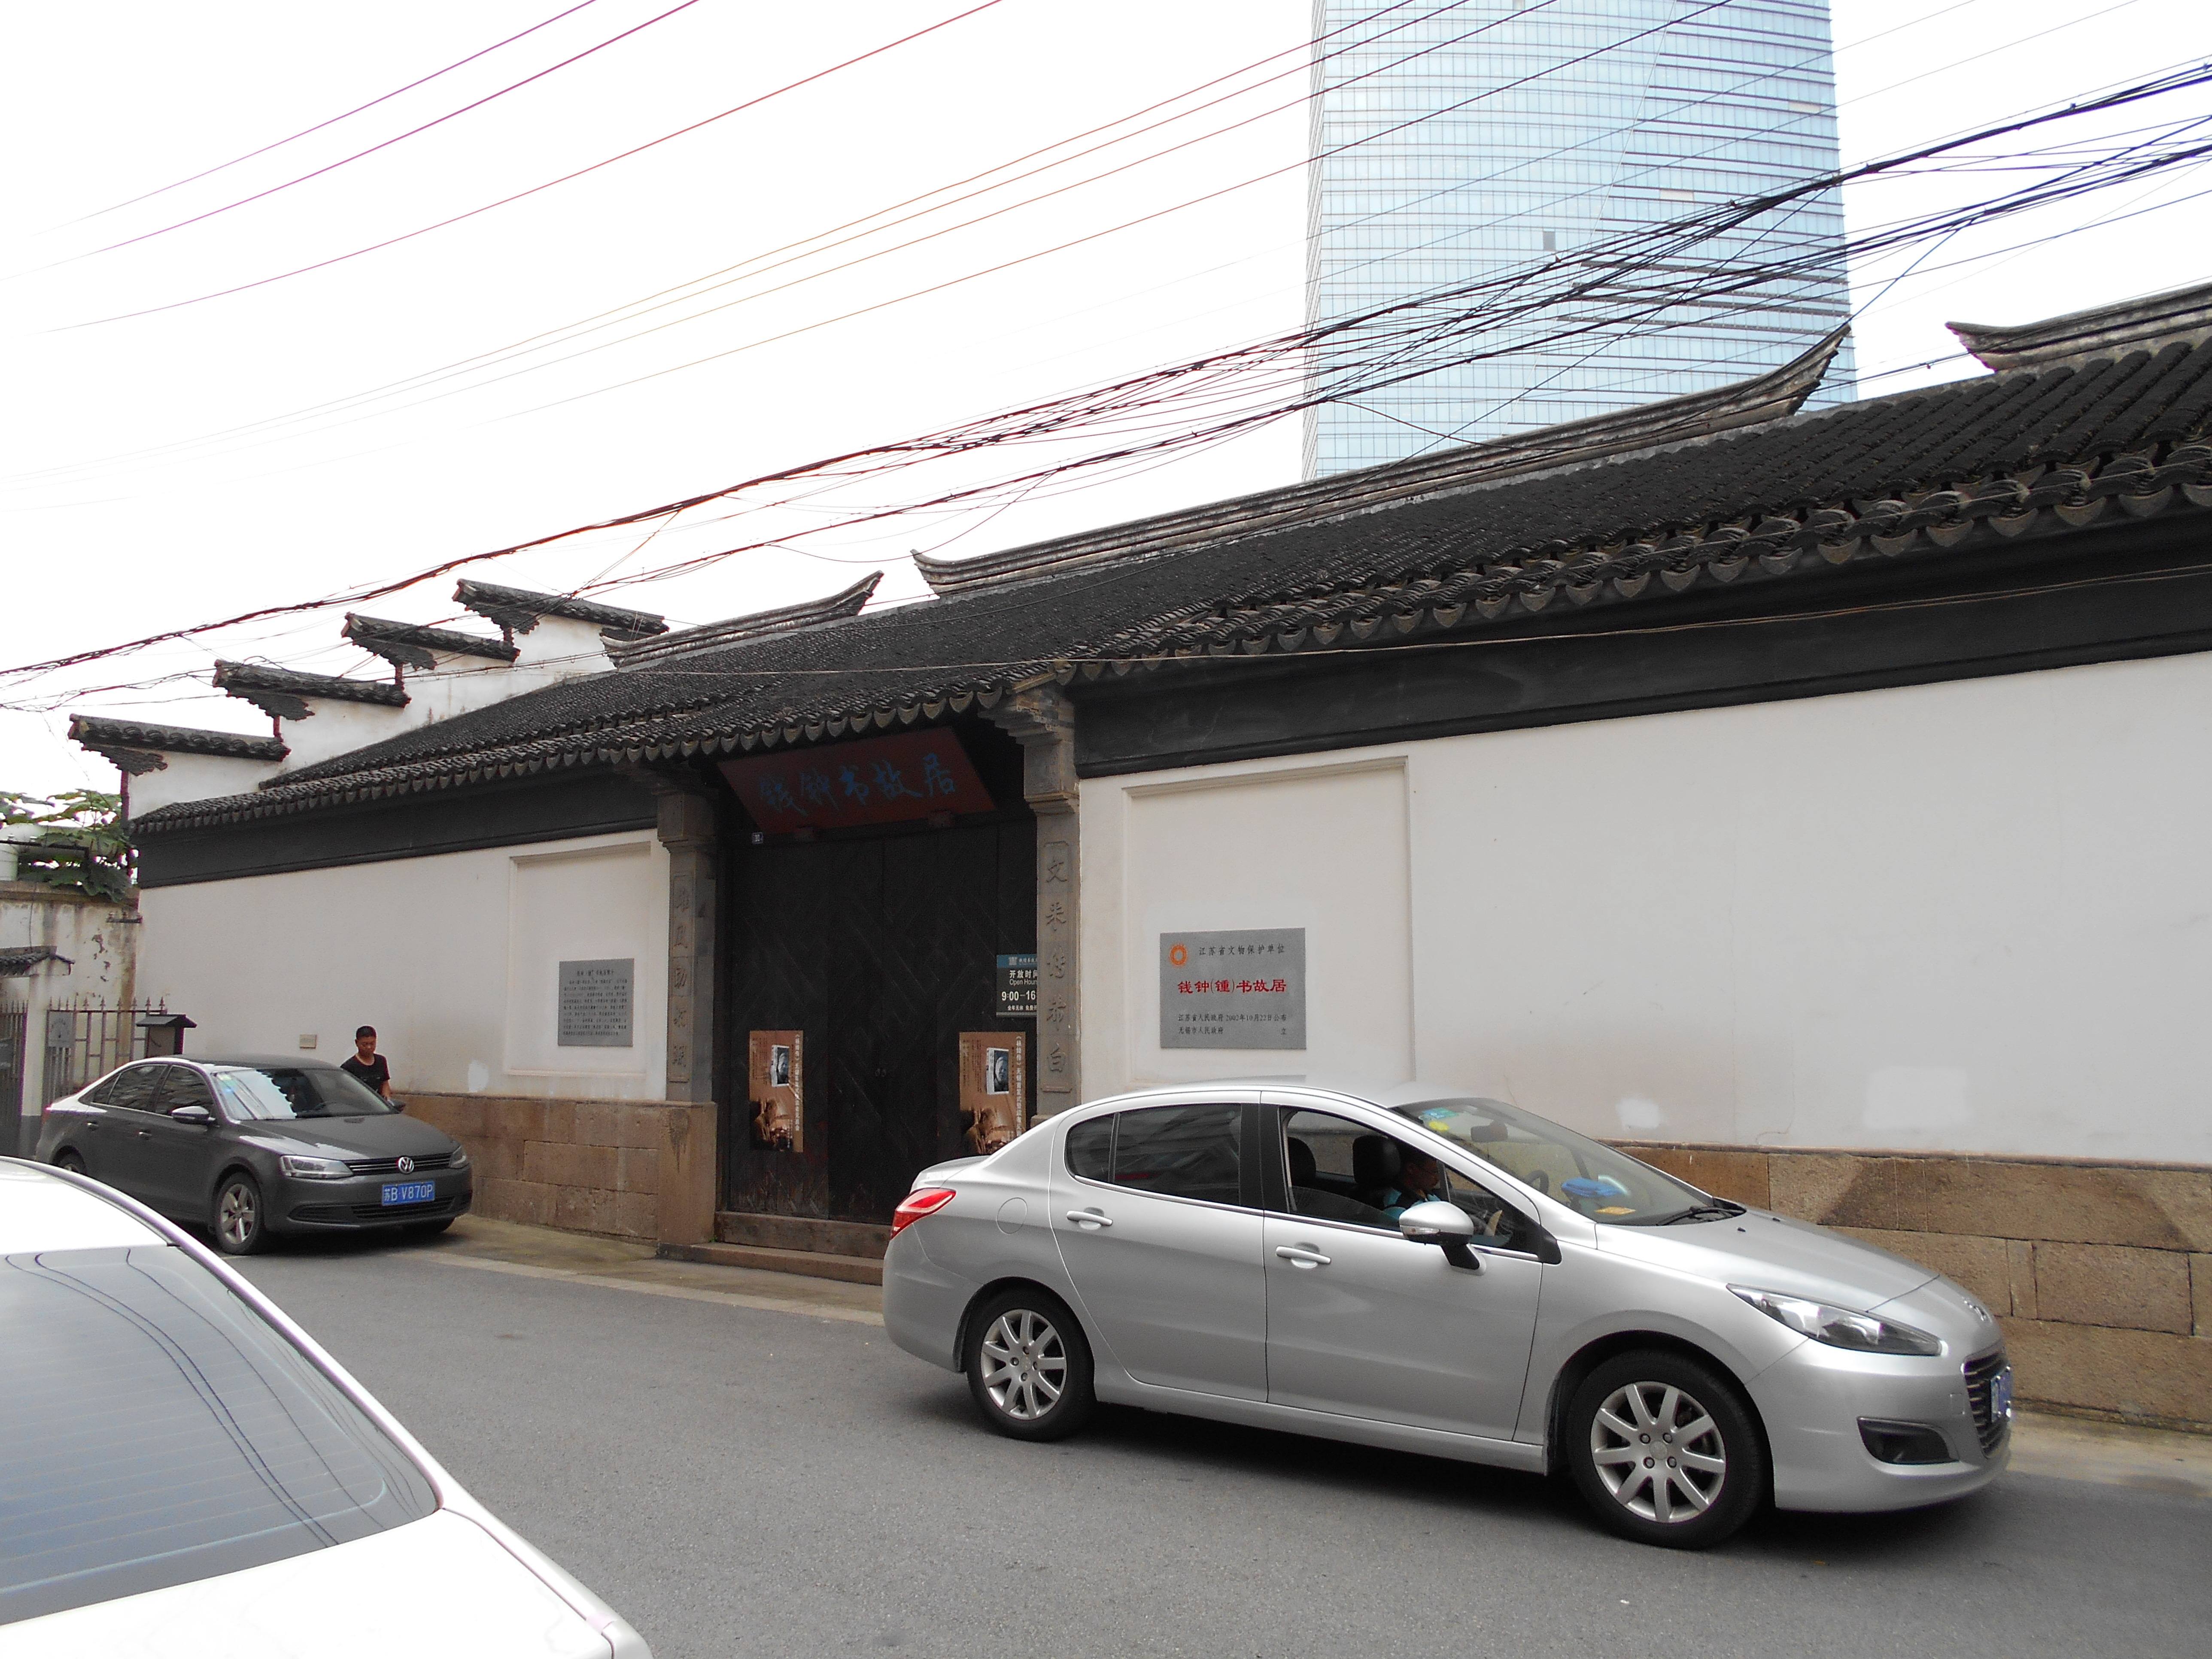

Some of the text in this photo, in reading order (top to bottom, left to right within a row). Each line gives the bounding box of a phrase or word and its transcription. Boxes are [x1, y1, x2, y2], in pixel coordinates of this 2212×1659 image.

[1199, 943, 1285, 956] 江苏省文物保护单位
[1178, 1014, 1223, 1022] 江苏省人民政府
